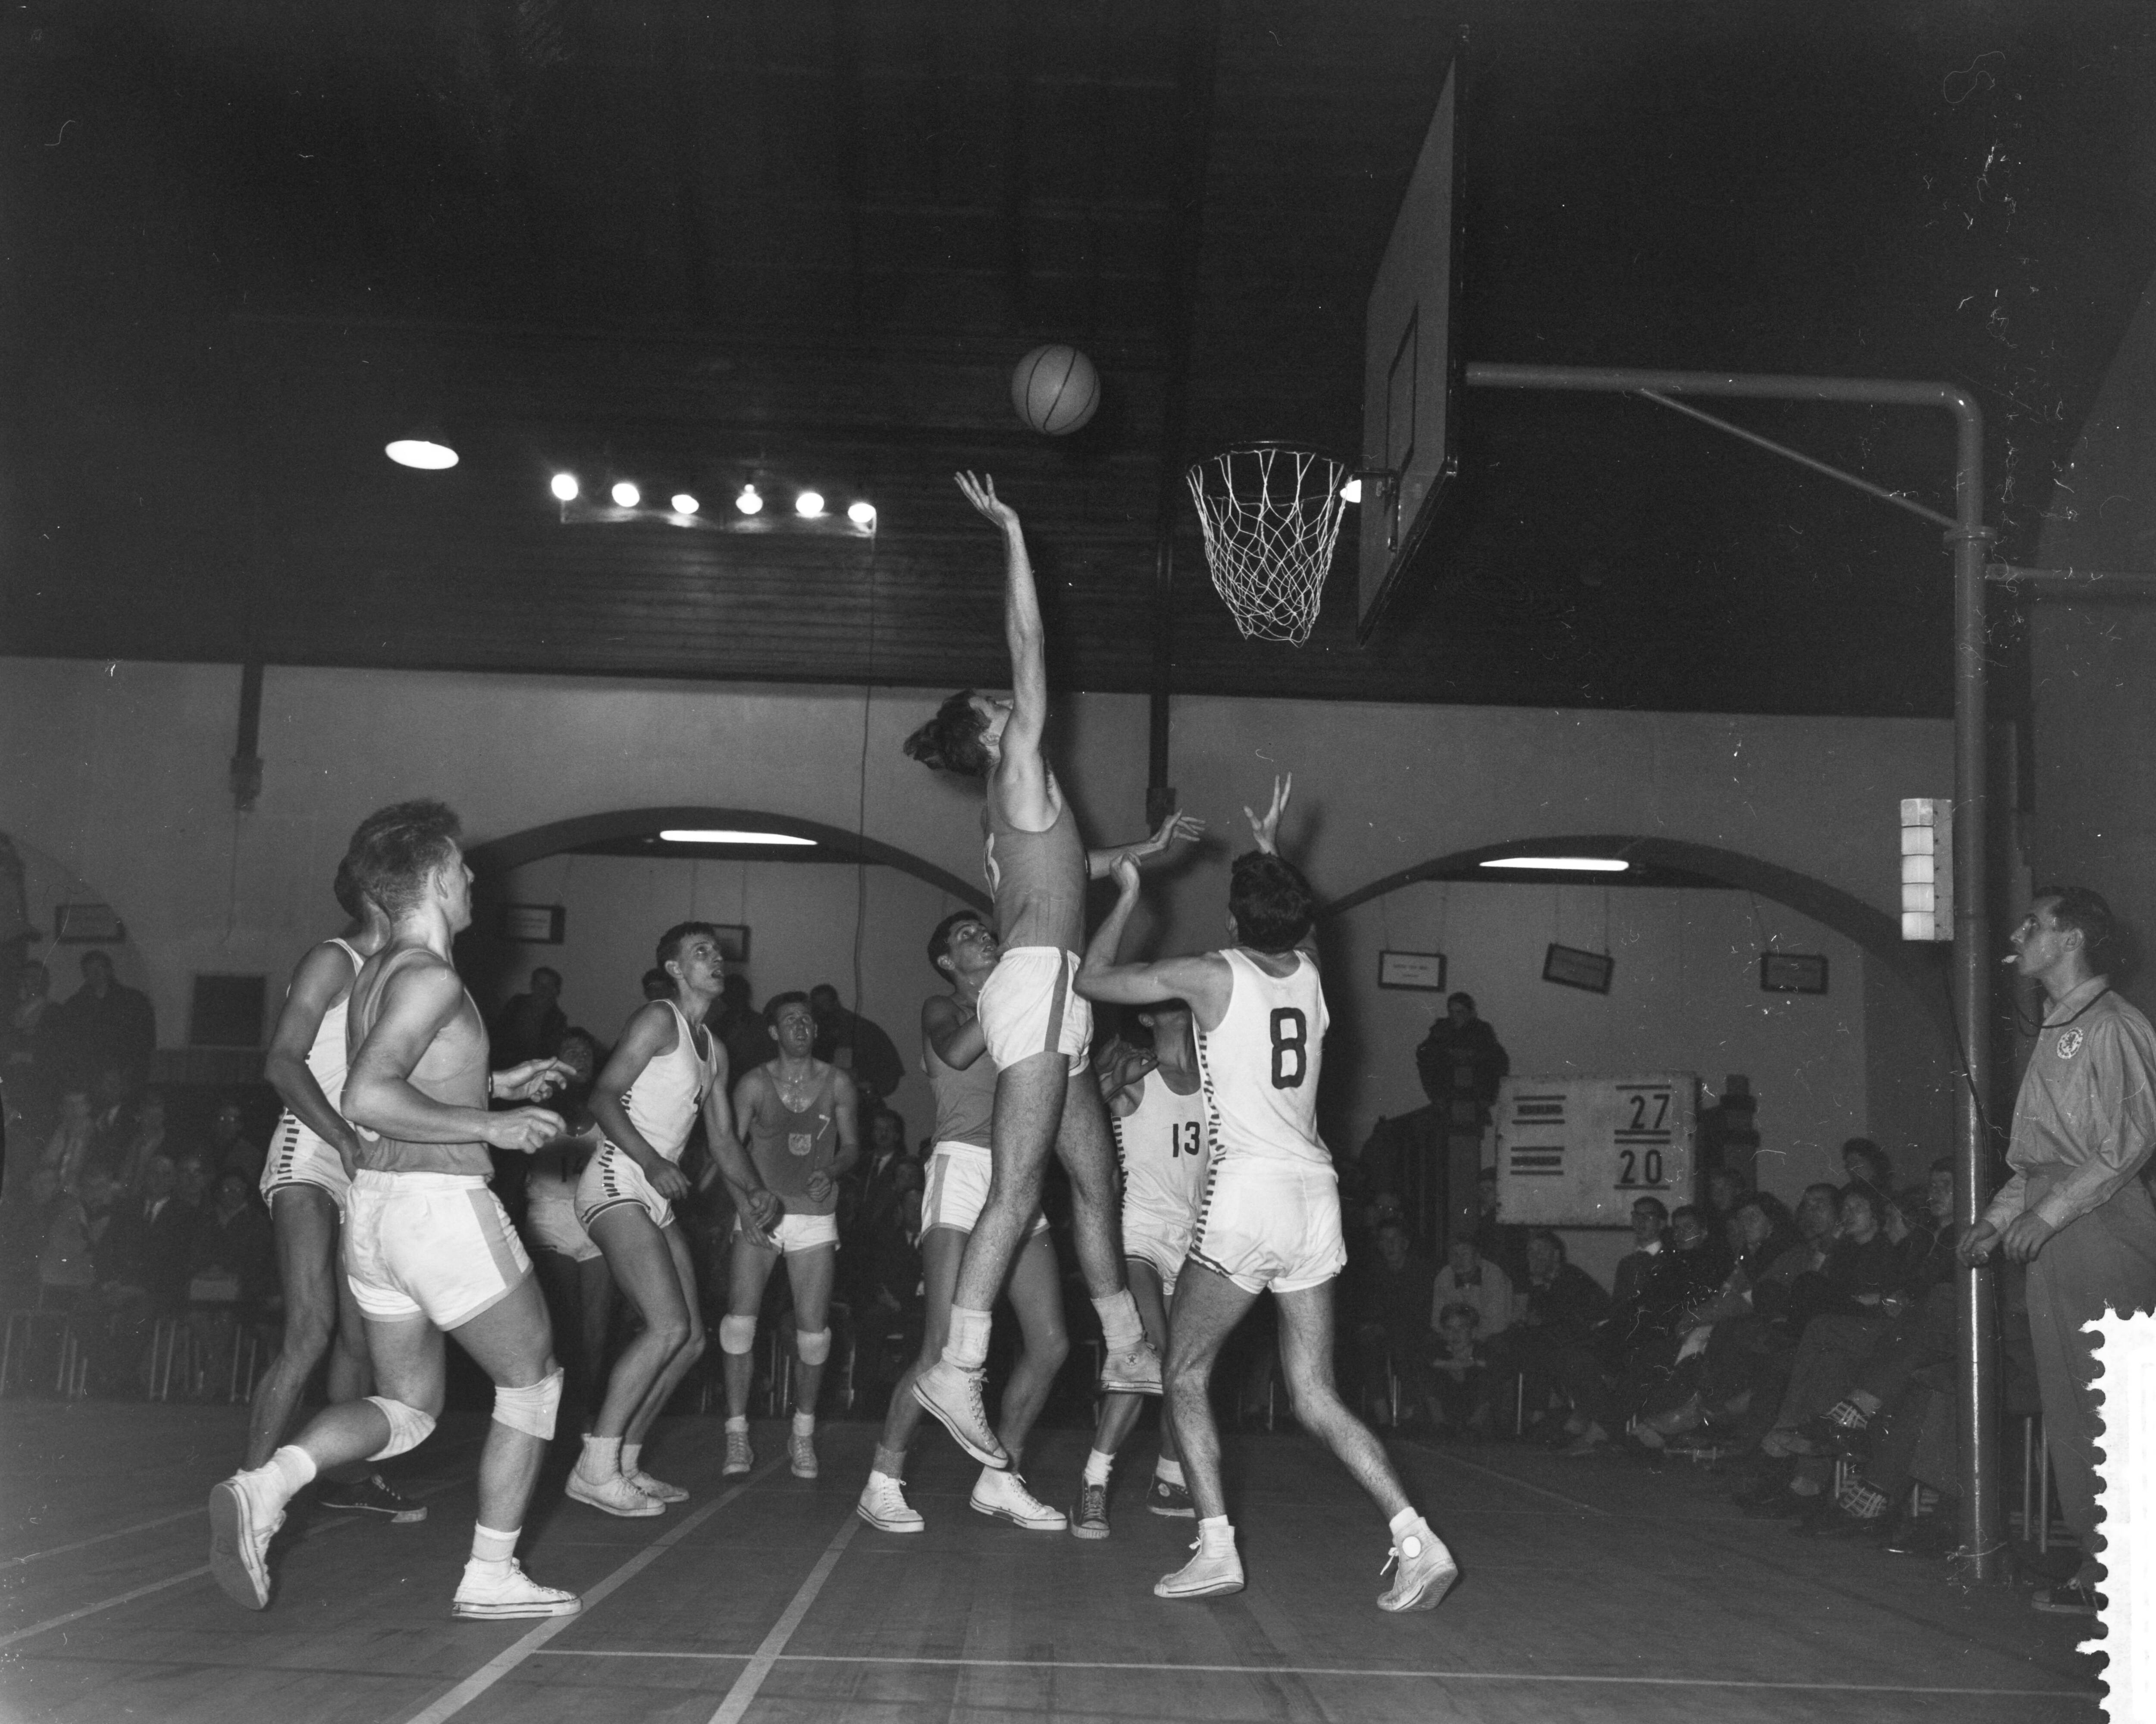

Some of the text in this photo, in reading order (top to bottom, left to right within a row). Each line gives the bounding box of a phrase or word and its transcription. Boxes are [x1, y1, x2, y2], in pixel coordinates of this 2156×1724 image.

[1270, 1007, 1307, 1090] 8
[816, 1114, 831, 1140] 7
[1630, 1094, 1670, 1129] 27
[1172, 1121, 1200, 1158] 13
[1620, 1149, 1662, 1184] 20
